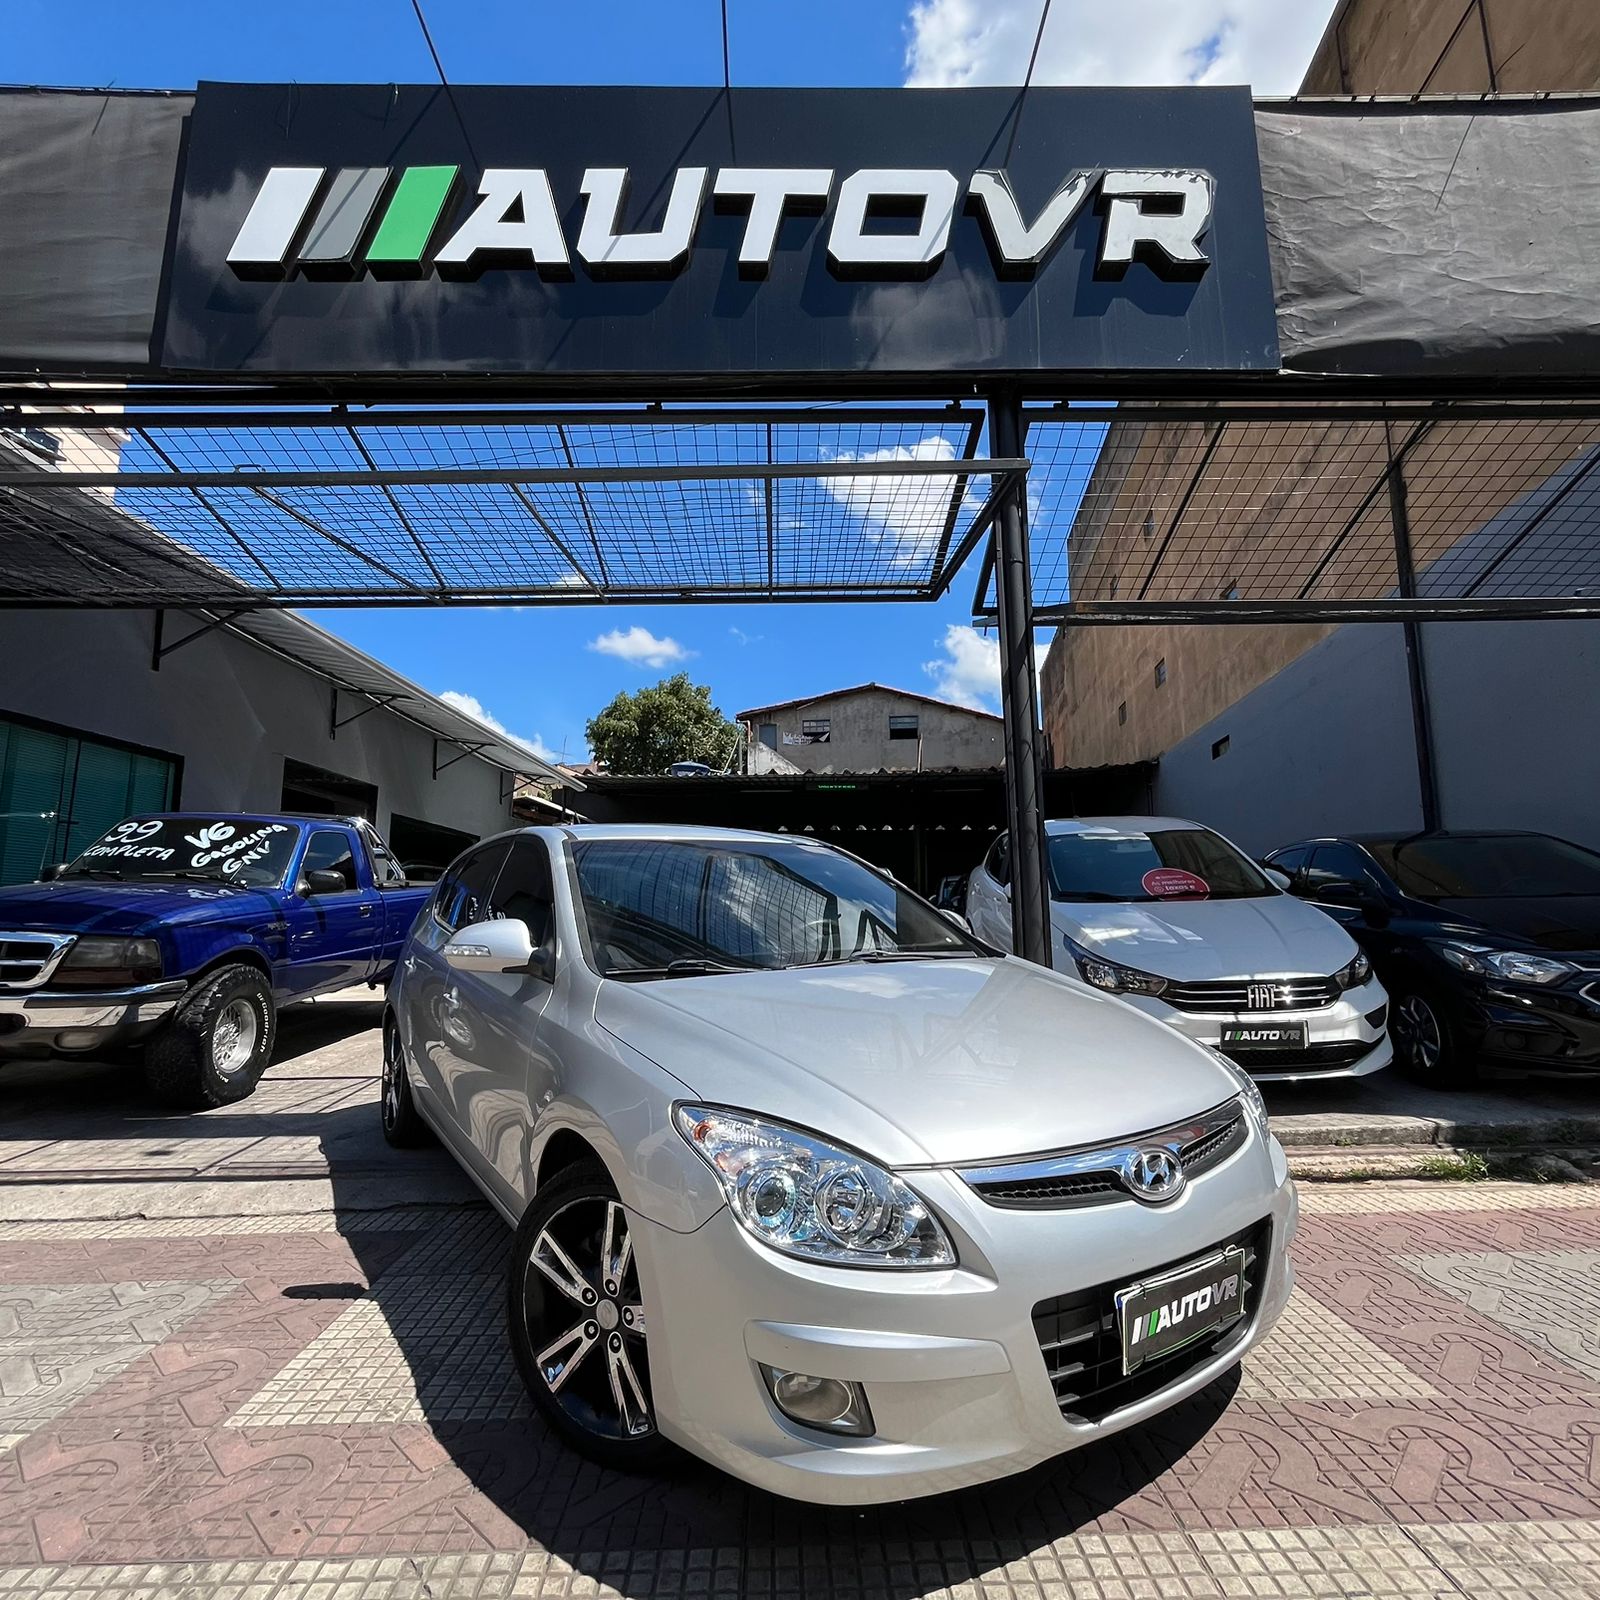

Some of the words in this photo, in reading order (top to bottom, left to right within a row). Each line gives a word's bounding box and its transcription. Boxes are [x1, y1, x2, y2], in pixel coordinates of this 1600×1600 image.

[433, 166, 1215, 270] AUTOVR
[104, 820, 164, 843] 99
[184, 821, 235, 849] V6
[84, 845, 175, 861] COMPLETA
[222, 841, 270, 874] GNV
[1247, 984, 1276, 1008] FIAT
[1240, 1030, 1301, 1041] AUTOVR
[1156, 1273, 1239, 1334] AUTOVR
